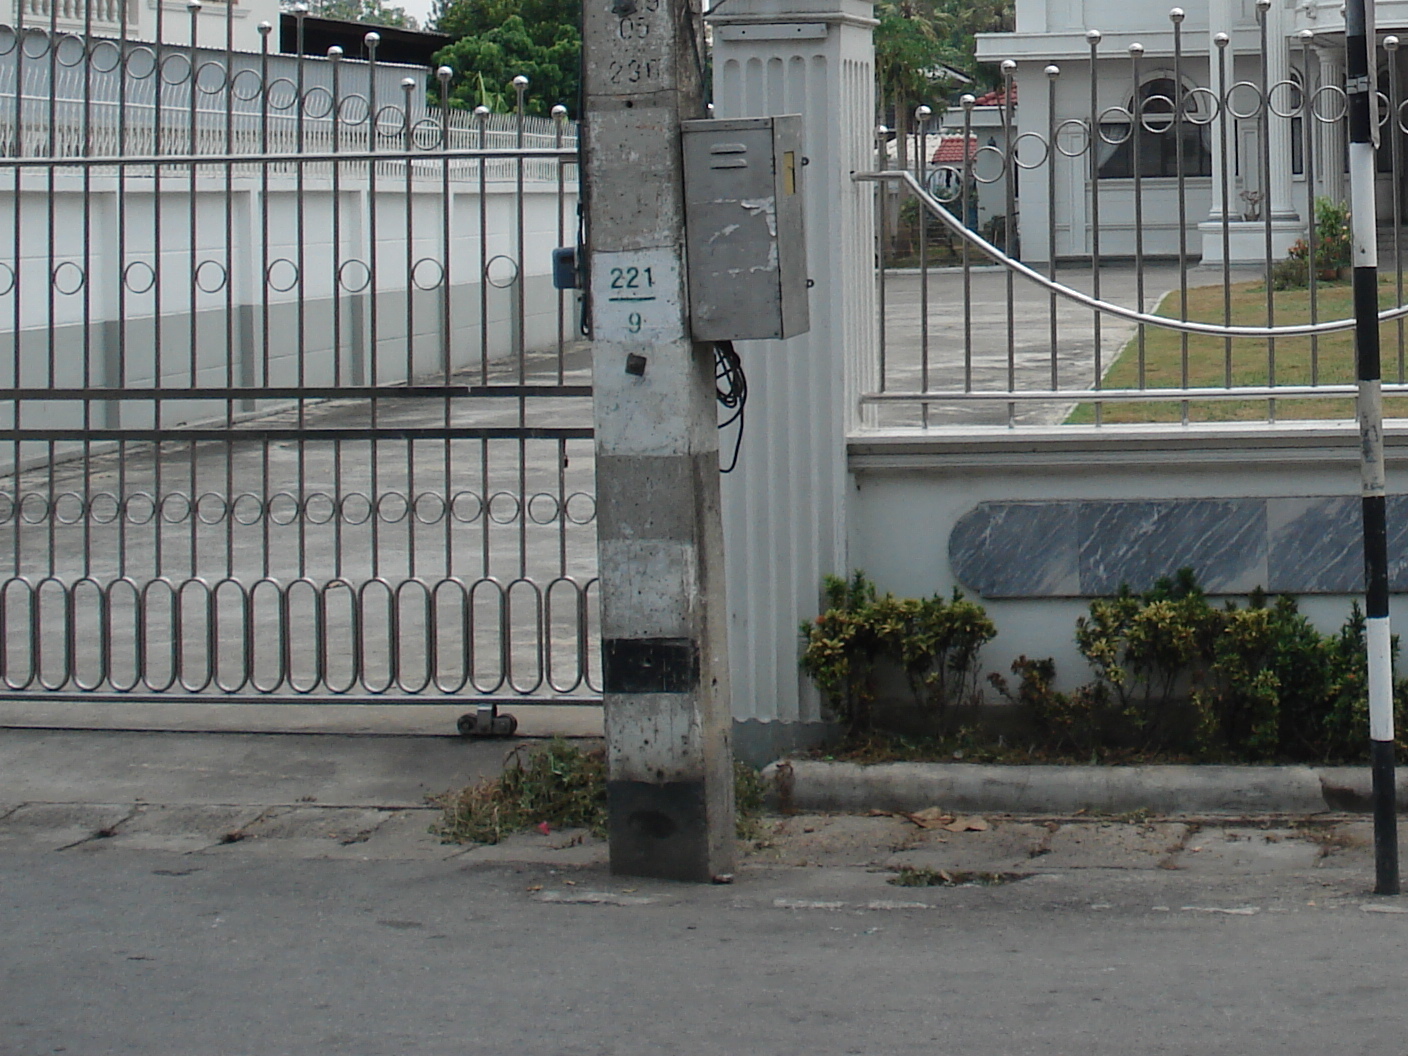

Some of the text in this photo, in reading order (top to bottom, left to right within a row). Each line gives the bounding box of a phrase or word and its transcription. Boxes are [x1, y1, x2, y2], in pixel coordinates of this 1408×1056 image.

[619, 17, 650, 40] 05
[610, 267, 653, 289] 221
[628, 312, 642, 334] 9
